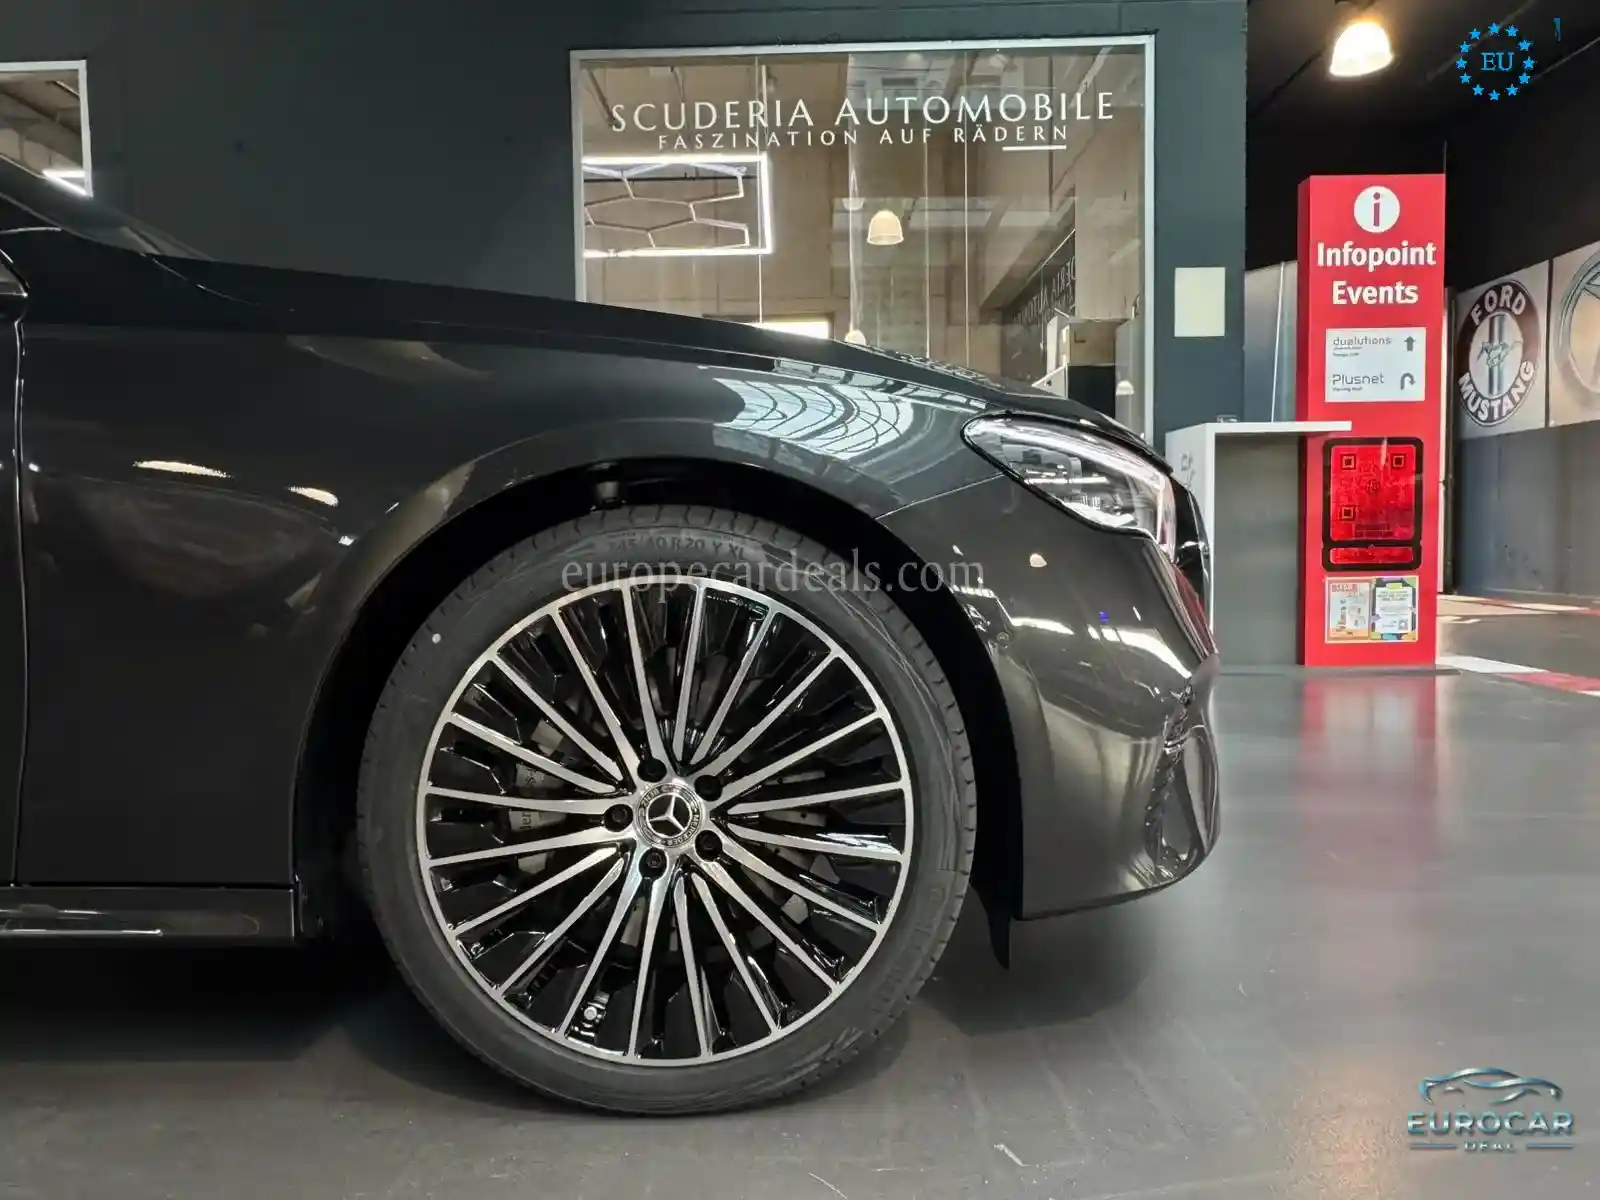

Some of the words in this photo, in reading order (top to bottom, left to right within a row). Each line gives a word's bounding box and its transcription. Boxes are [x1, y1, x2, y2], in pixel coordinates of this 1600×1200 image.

[611, 98, 814, 132] SCUDERIA
[834, 92, 1113, 126] AUTOMOBILE
[658, 130, 857, 150] FASZINATION
[880, 128, 931, 144] AUF
[953, 124, 1067, 144] RÄDERN
[1317, 240, 1437, 272] Infopoint
[1332, 280, 1419, 305] Events
[1471, 284, 1526, 326] FORD
[1332, 372, 1385, 386] Plusnet
[1458, 361, 1535, 421] MUSTANG
